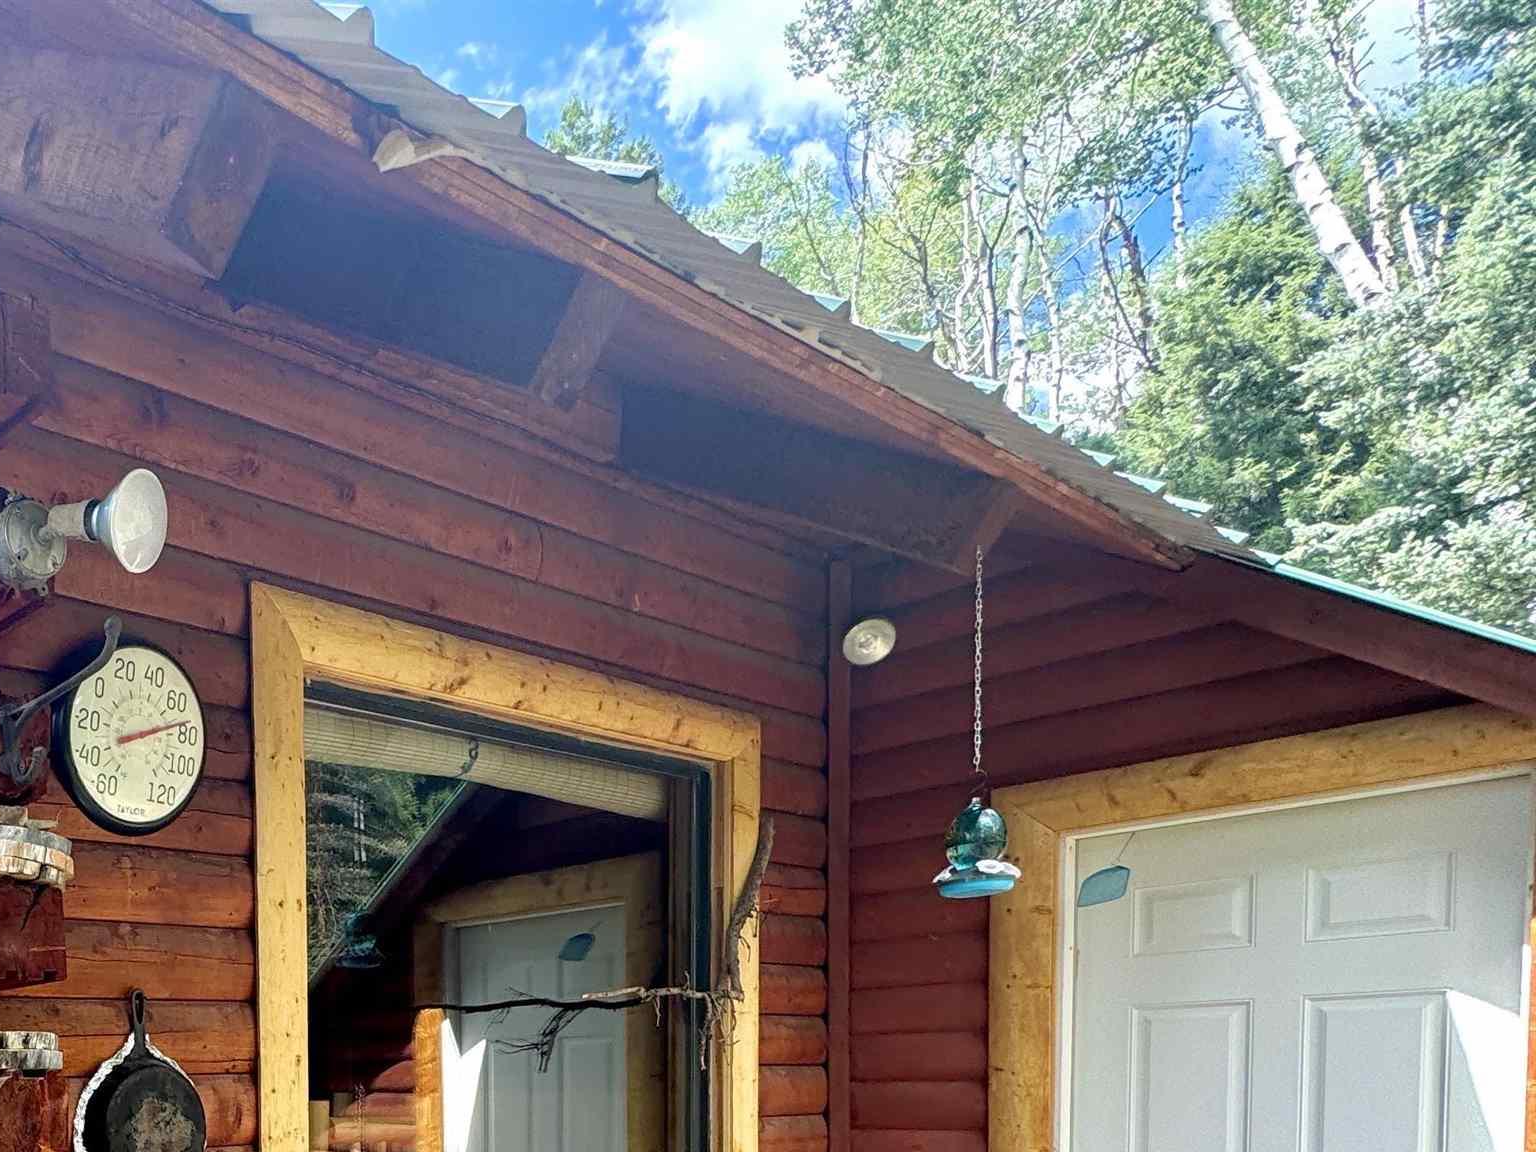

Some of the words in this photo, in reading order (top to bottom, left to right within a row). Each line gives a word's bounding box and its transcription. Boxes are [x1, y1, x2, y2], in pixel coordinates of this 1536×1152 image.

[114, 658, 136, 682] 20
[144, 664, 165, 688] 40
[94, 677, 105, 698] 0
[166, 690, 187, 713] 60
[177, 723, 198, 746] 80
[168, 752, 195, 777] 100
[147, 782, 176, 806] 120
